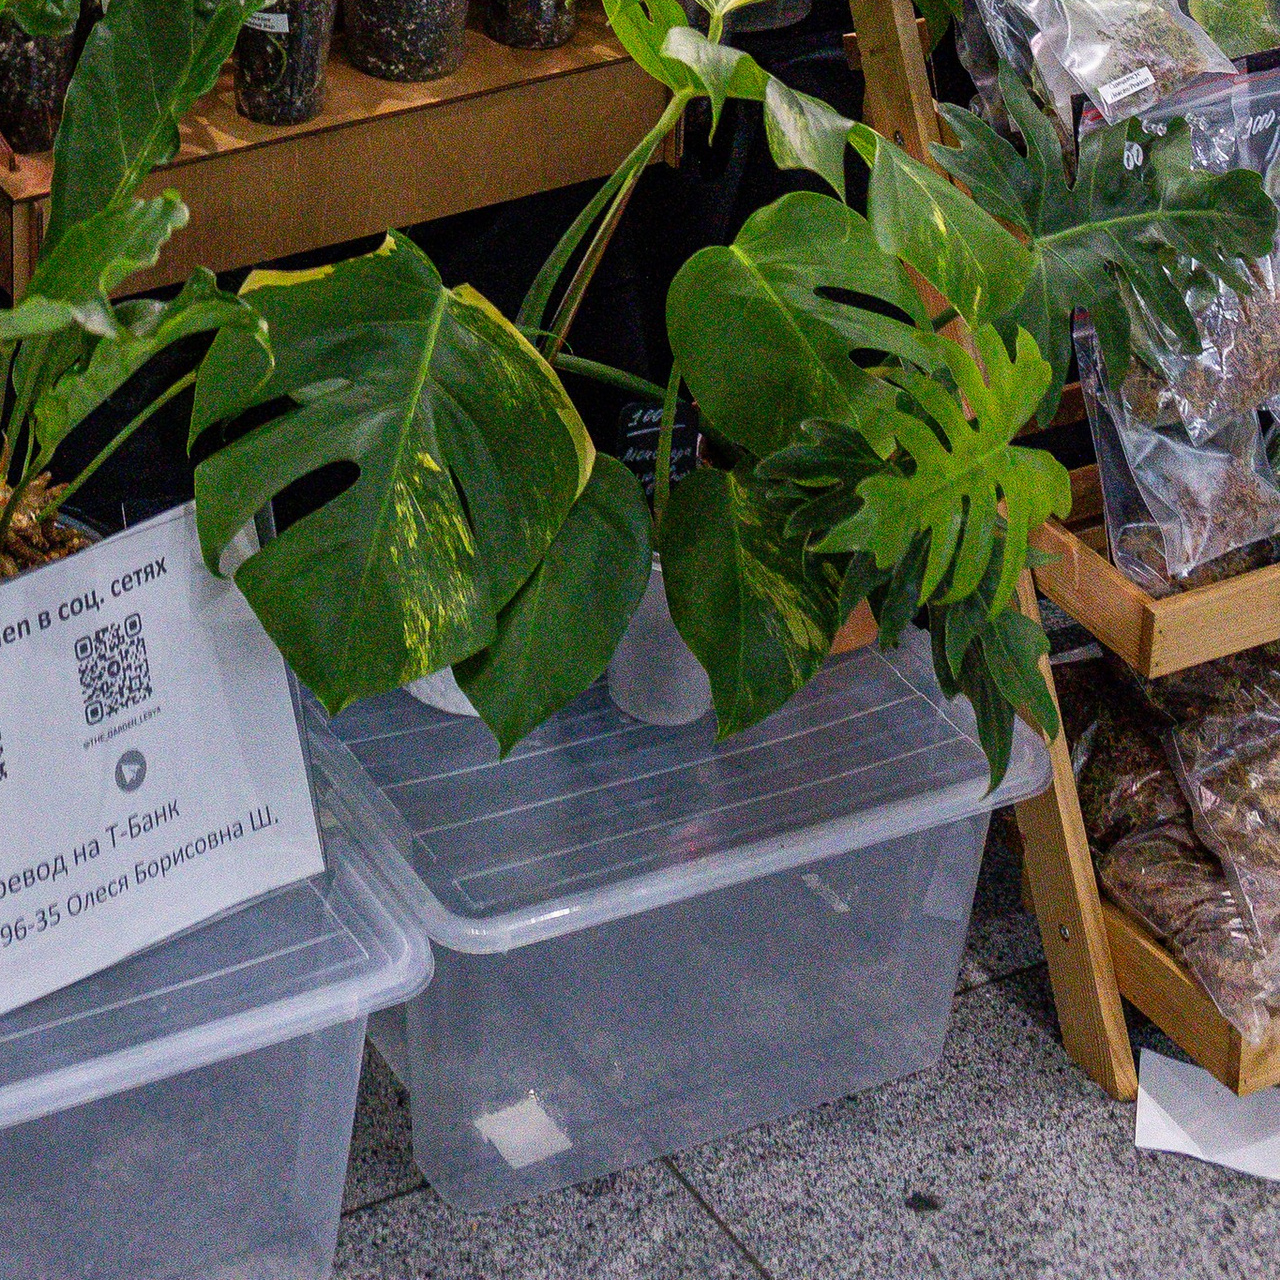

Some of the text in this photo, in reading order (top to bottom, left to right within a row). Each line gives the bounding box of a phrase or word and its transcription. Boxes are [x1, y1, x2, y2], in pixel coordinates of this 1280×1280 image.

[38, 611, 52, 631] в
[58, 590, 106, 622] соц.
[110, 556, 168, 598] сетях
[66, 875, 129, 919] Олеся
[134, 823, 245, 888] Борисовна
[249, 805, 280, 834] Ш.
[73, 839, 101, 866] на
[104, 797, 180, 849] Т-Банк
